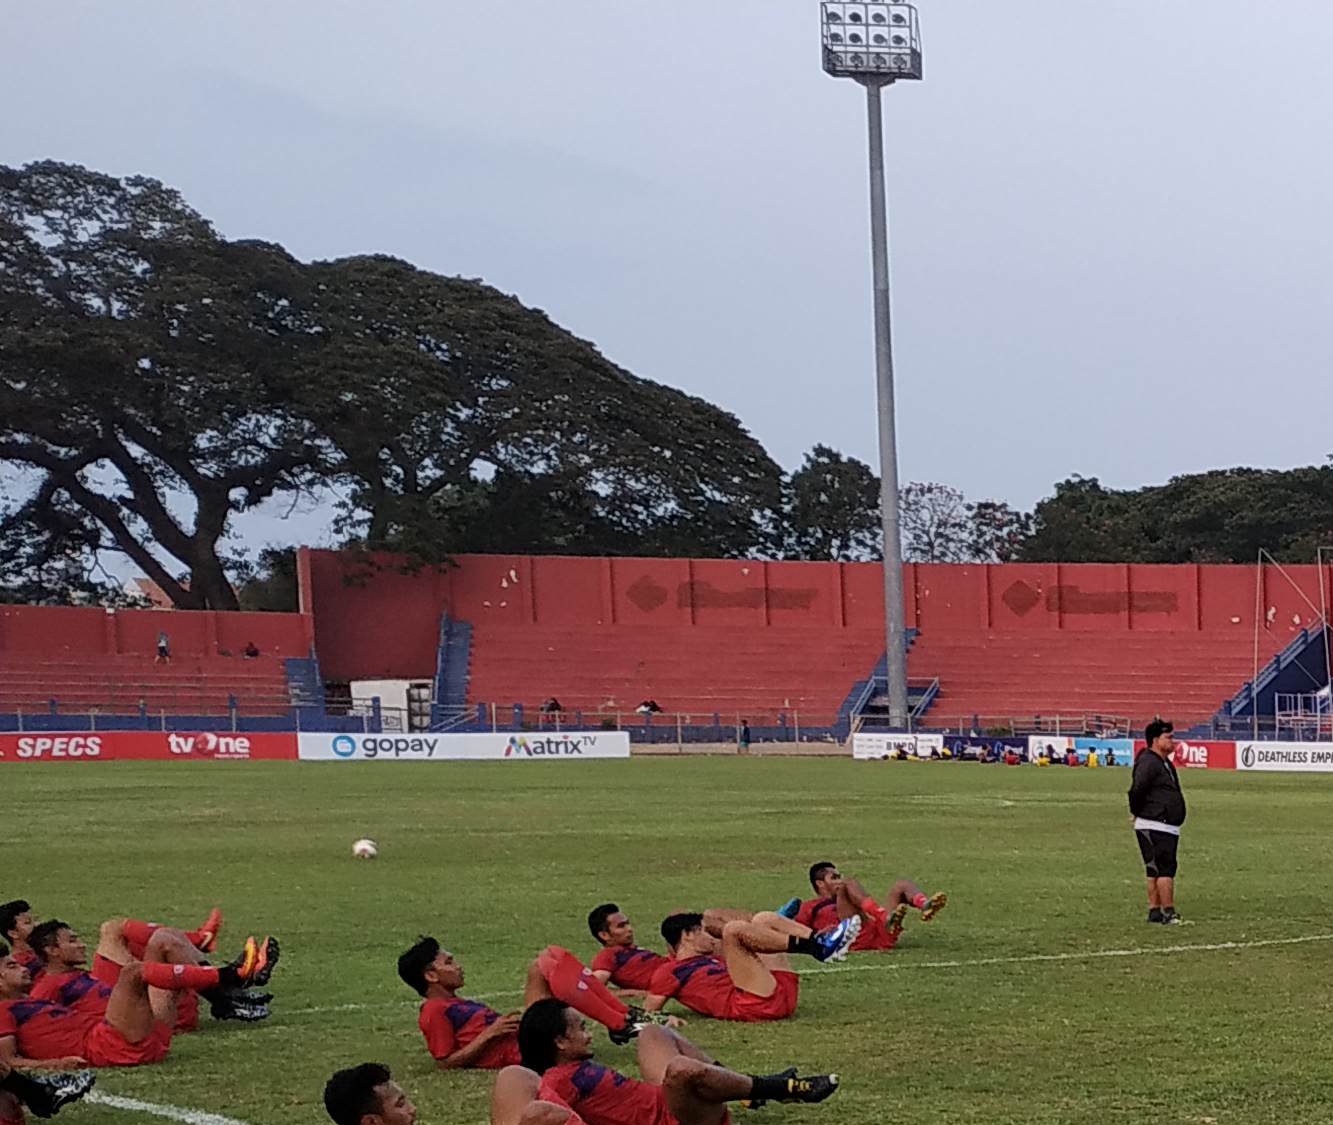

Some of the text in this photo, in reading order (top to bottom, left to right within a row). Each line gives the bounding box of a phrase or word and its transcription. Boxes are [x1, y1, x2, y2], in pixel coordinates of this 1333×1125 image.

[16, 736, 103, 758] SPECS
[361, 737, 438, 758] gopay
[1257, 751, 1308, 764] DEATHLESS
